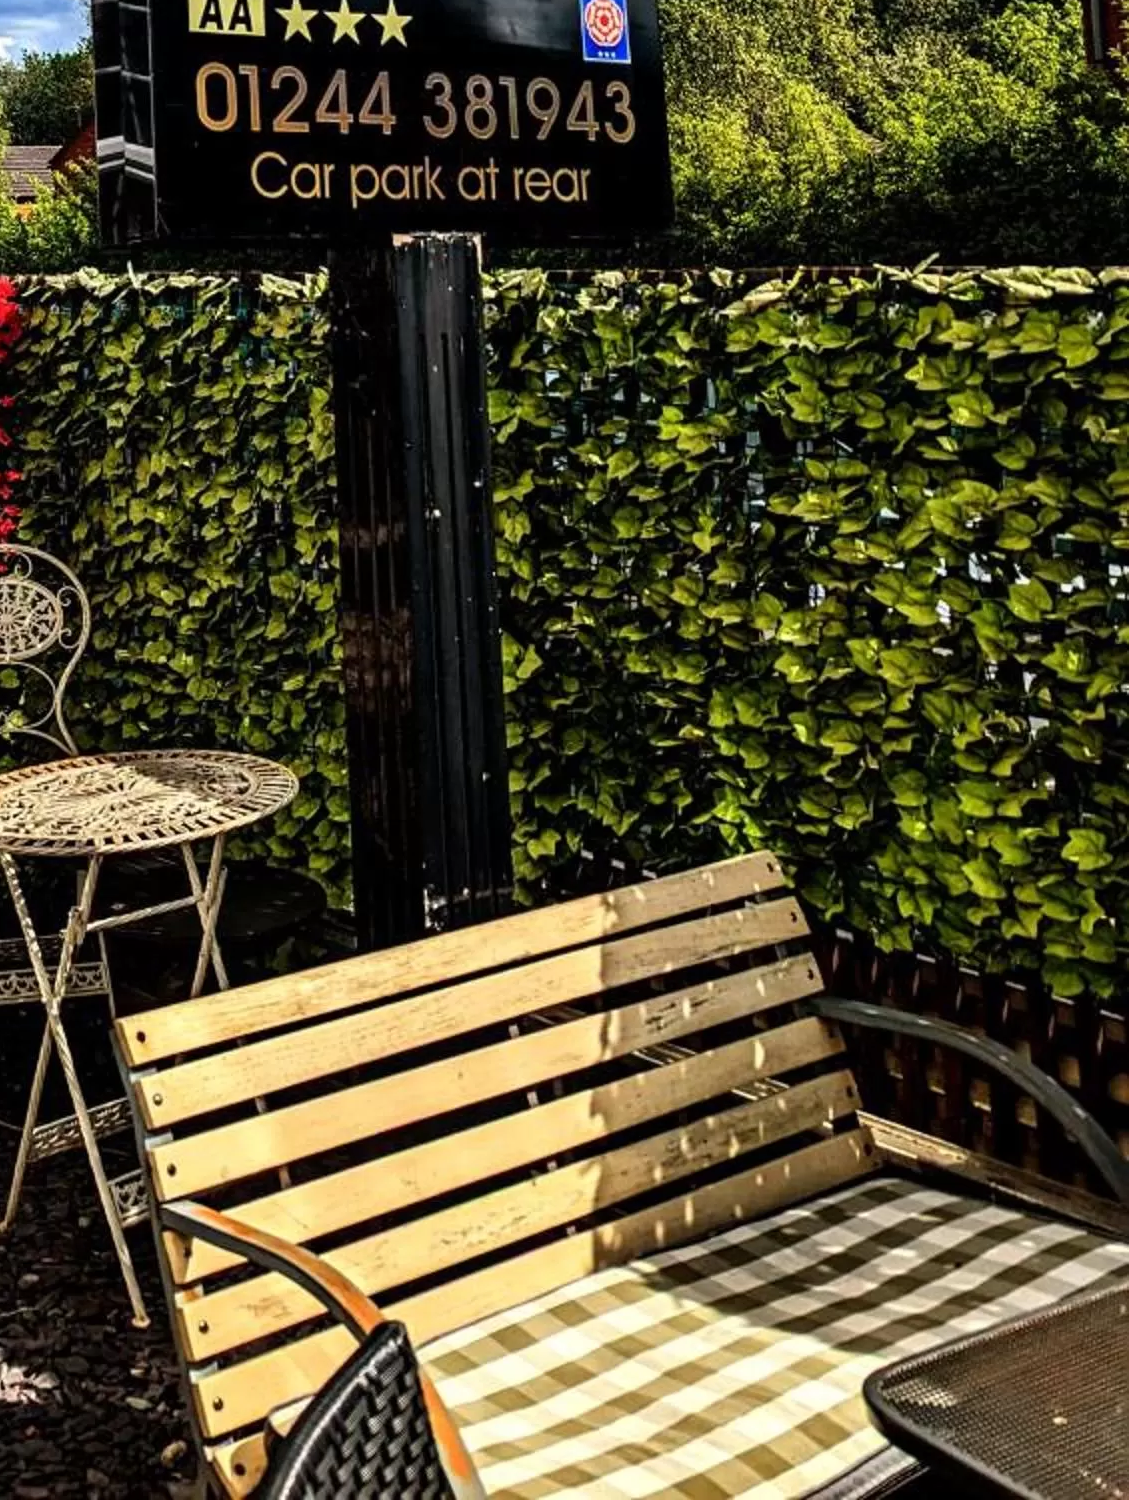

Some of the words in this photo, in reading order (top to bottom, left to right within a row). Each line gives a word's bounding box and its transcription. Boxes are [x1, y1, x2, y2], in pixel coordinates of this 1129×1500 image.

[195, 61, 397, 135] 01244
[422, 72, 637, 144] 381943
[251, 151, 335, 199] Car
[350, 156, 444, 209] park
[457, 157, 501, 201] at
[512, 165, 592, 202] rear
